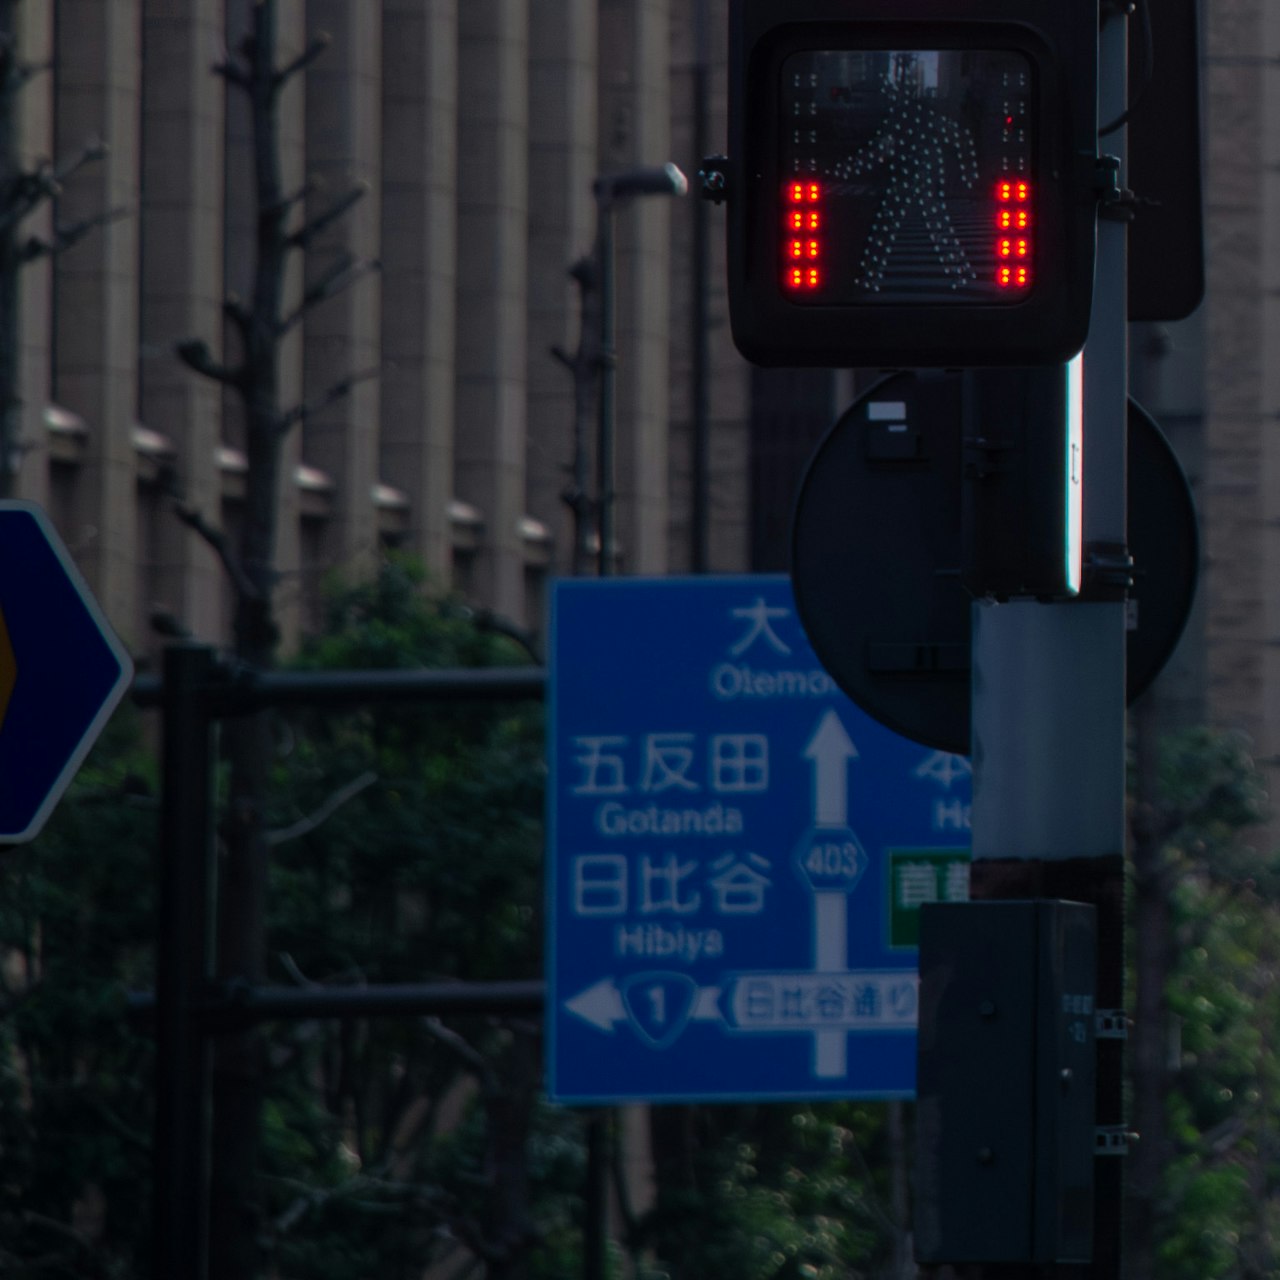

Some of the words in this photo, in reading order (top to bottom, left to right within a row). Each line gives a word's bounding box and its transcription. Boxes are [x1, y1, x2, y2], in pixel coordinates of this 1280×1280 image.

[731, 598, 809, 657] 大
[573, 733, 769, 795] 五反田
[600, 801, 743, 834] Gotanda
[805, 843, 858, 877] 403
[574, 853, 772, 914] 日比谷
[619, 923, 723, 961] Hibiya
[646, 985, 666, 1026] 1
[747, 981, 918, 1017] 日比谷通り
